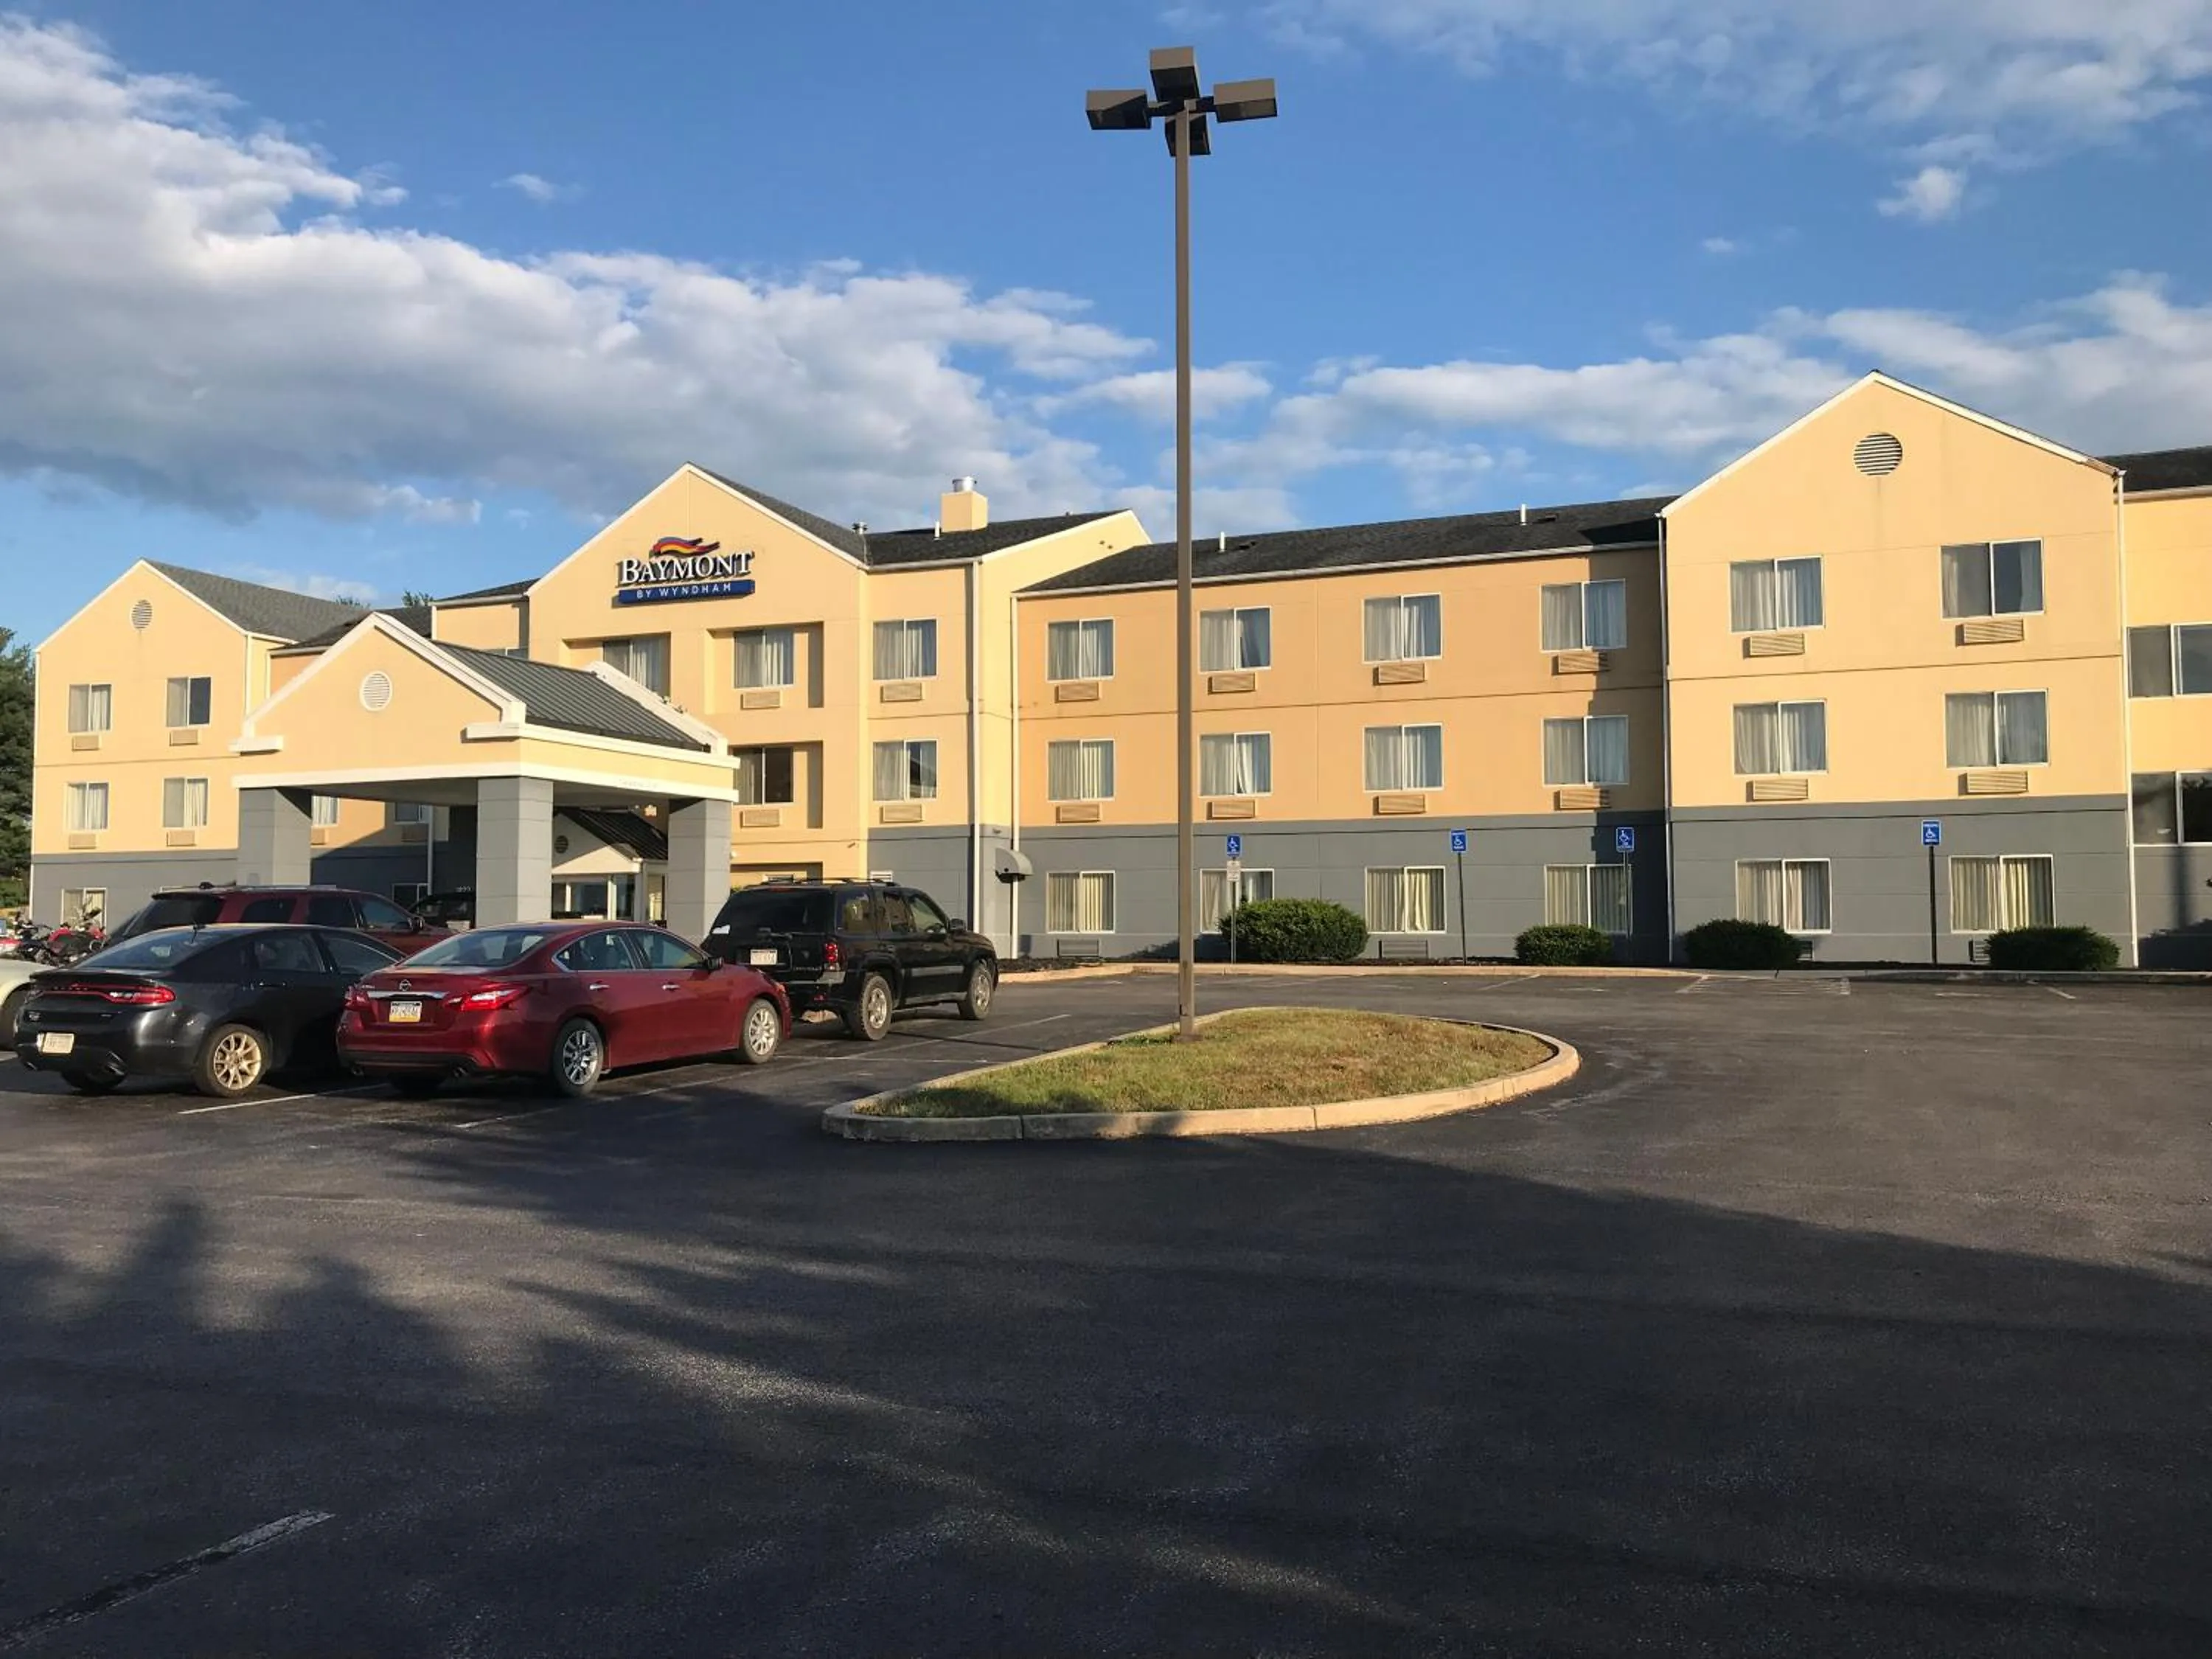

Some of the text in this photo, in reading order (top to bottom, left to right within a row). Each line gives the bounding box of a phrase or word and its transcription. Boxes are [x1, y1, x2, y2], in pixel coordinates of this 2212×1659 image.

[620, 552, 754, 583] BAYMONT
[636, 582, 731, 599] BY WYNDHAM
